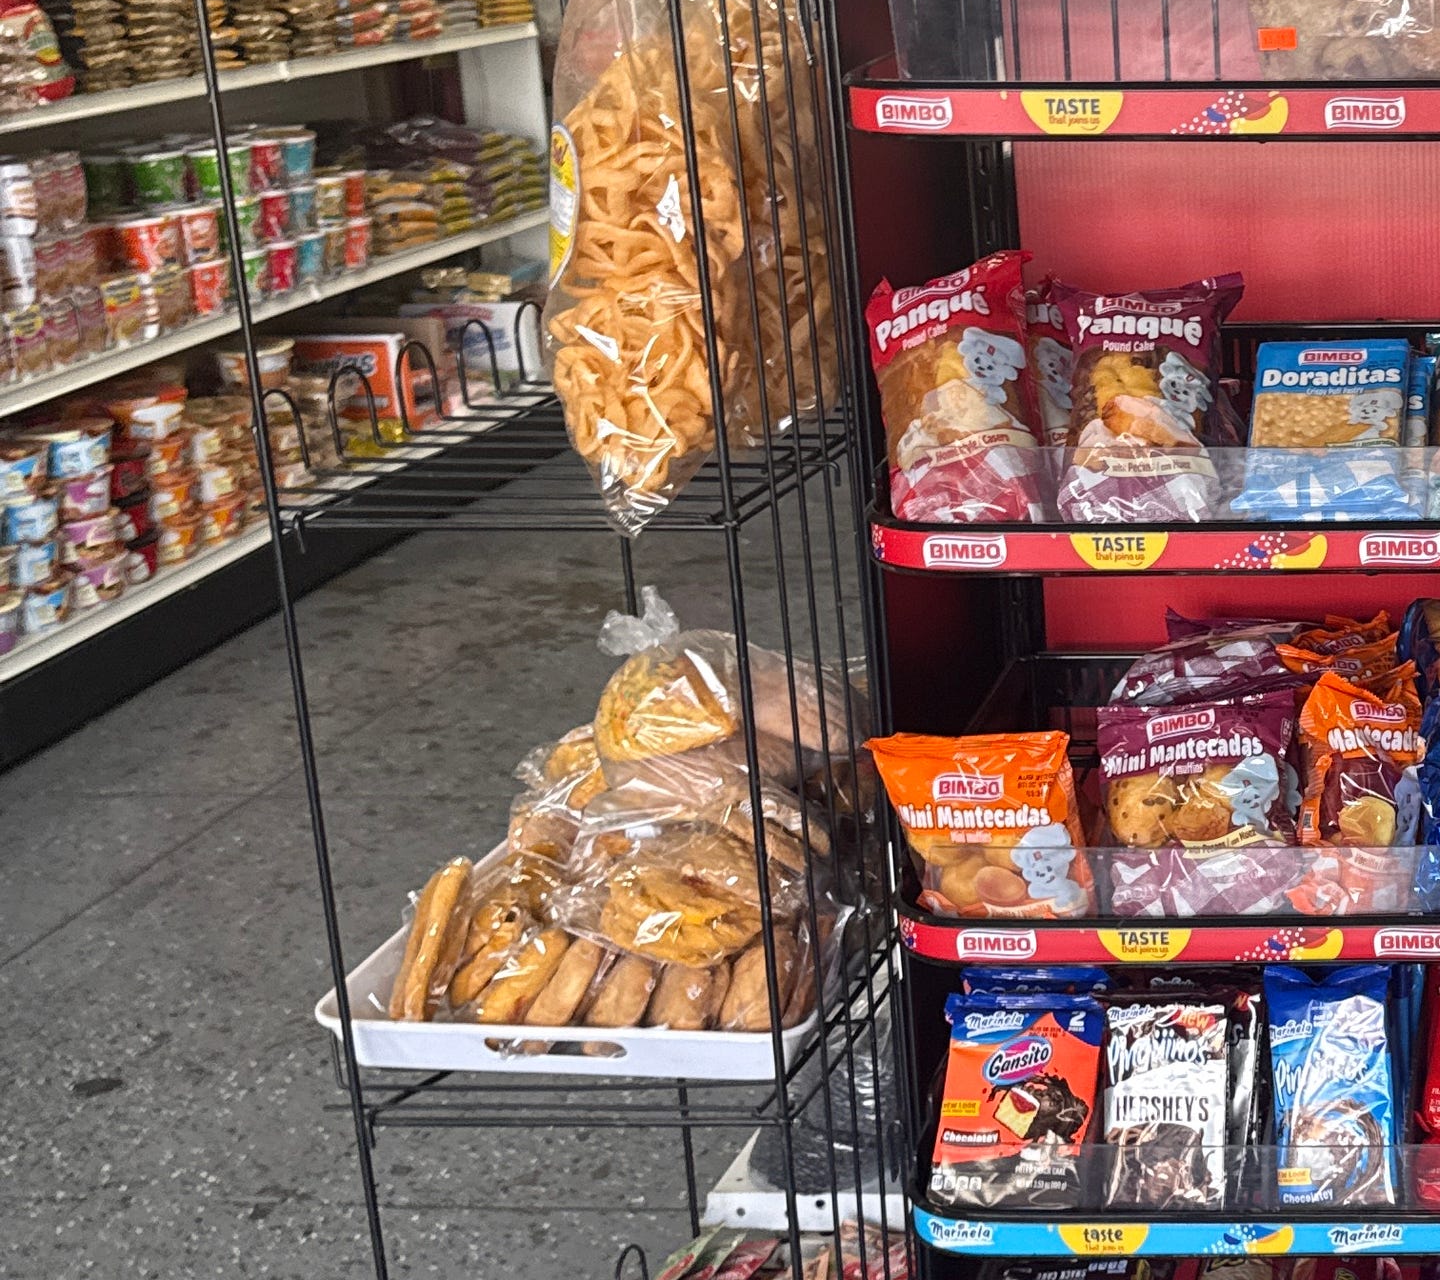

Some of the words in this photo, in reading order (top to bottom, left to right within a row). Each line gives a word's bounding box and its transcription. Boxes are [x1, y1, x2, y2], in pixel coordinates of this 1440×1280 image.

[882, 104, 947, 121] BIMBO
[1045, 98, 1100, 114] TASTE
[1331, 105, 1400, 121] BIMBO
[875, 289, 990, 348] Panqué
[1103, 340, 1132, 353] Pound
[1133, 340, 1155, 352] Cake
[1304, 352, 1363, 362] BIMBO
[1262, 367, 1401, 387] Doraditas
[928, 542, 1002, 561] BIMBO
[1092, 537, 1146, 551] TASTE
[1365, 539, 1438, 558] BIMBO
[1096, 552, 1112, 561] that
[1115, 552, 1133, 563] joins
[1135, 553, 1145, 561] us
[1152, 713, 1211, 736] BIMBO
[1106, 749, 1146, 777] Mini
[1150, 734, 1263, 767] Mantecadas
[938, 781, 999, 795] BIMBO
[936, 804, 1051, 829] Mantecadas
[962, 936, 1032, 953] BIMBO
[1118, 932, 1170, 945] TASTE
[1122, 945, 1138, 953] that
[1140, 946, 1156, 955] joins
[966, 1011, 1024, 1030] Marinela
[1069, 1011, 1086, 1026] 2
[989, 1044, 1050, 1077] Gansito
[1107, 1029, 1209, 1085] Pingüinos
[1116, 1095, 1209, 1122] HERSHEY'S
[943, 1131, 999, 1144] Chocolatey
[931, 1222, 991, 1240] Marinela
[1084, 1228, 1123, 1243] taste
[1331, 1225, 1400, 1245] Marinela
